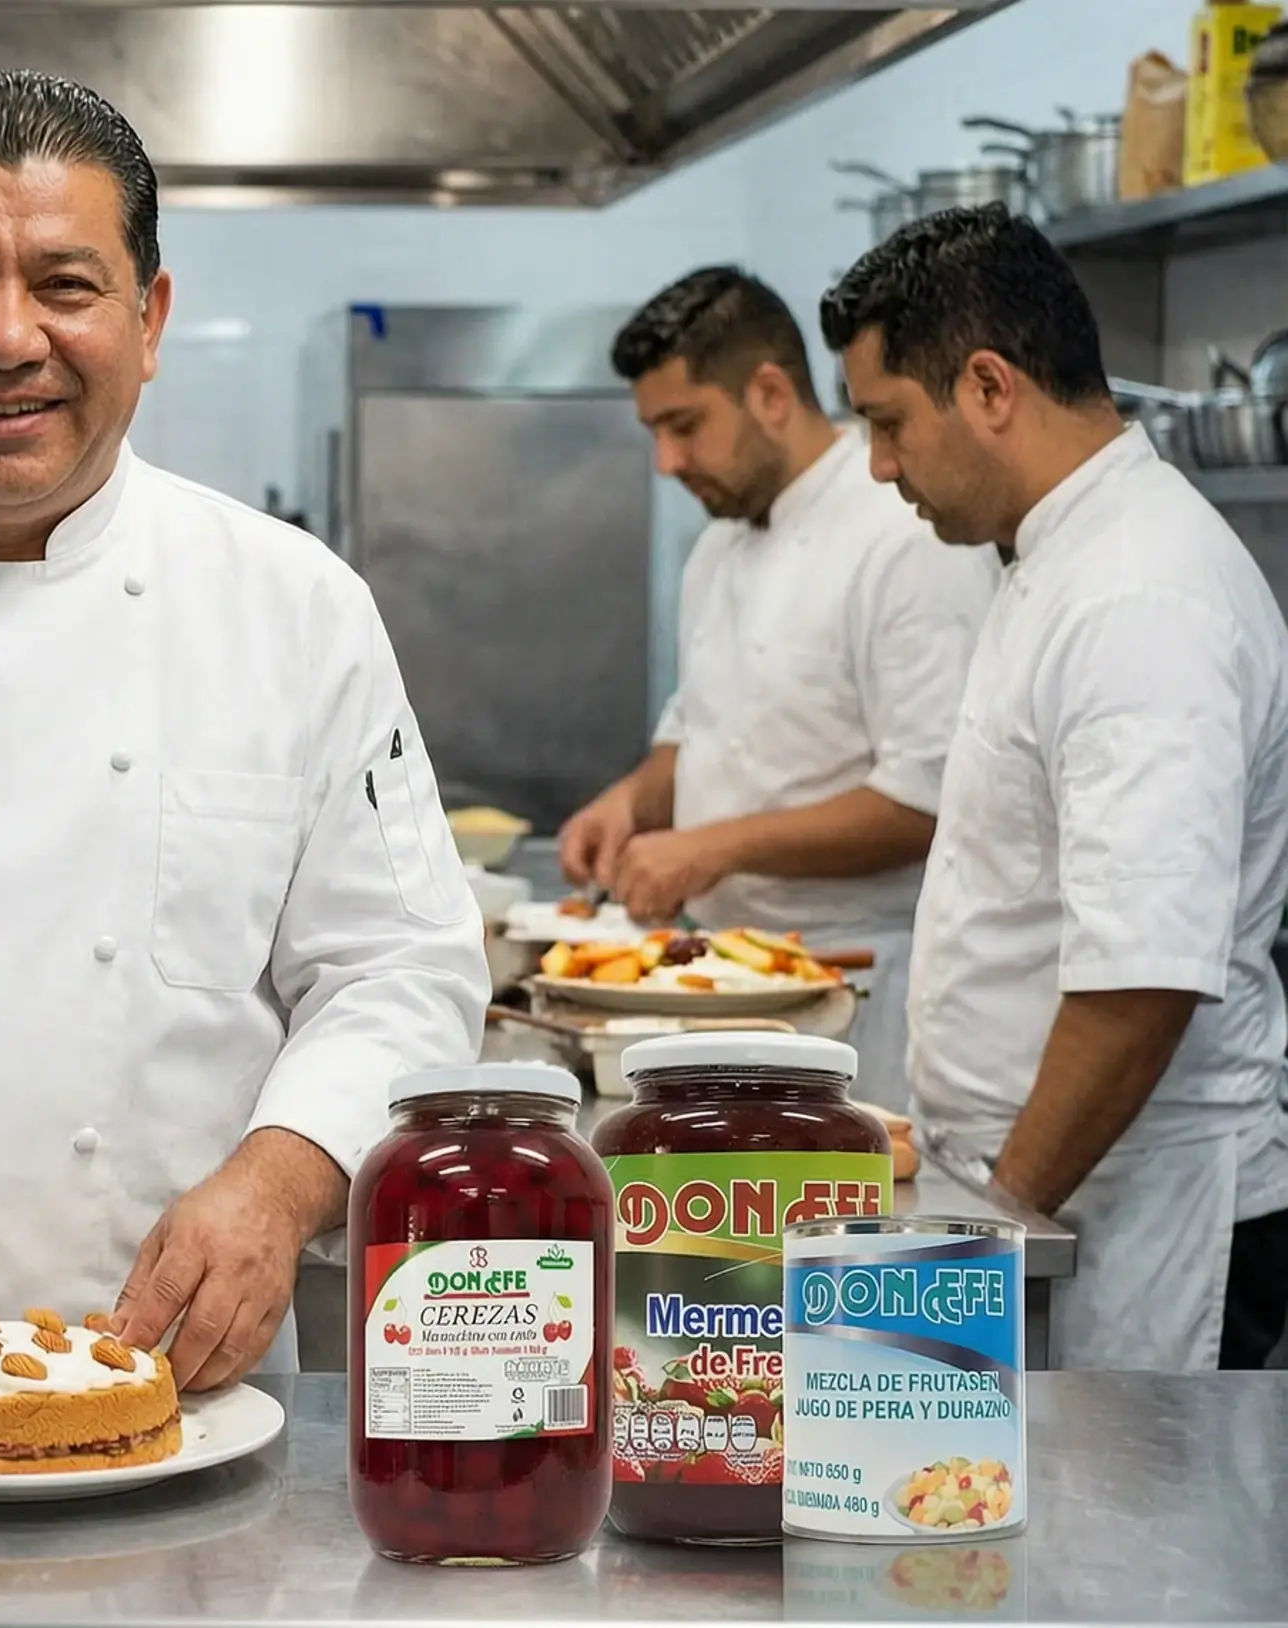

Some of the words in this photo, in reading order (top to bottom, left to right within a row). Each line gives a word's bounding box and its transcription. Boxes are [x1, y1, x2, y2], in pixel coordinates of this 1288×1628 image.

[617, 1180, 777, 1246] DON
[427, 1271, 481, 1295] DON
[484, 1270, 528, 1294] EFE
[802, 1268, 917, 1326] DON
[921, 1268, 1004, 1325] EFE
[420, 1303, 539, 1326] CEREZAS
[690, 1344, 726, 1377] de
[806, 1372, 872, 1391] MEZCLA
[877, 1373, 904, 1392] DE
[795, 1397, 831, 1418] JUGO
[835, 1400, 858, 1418] DE
[862, 1400, 915, 1419] PERA
[919, 1400, 933, 1420] Y
[937, 1399, 1011, 1420] DURAZNO
[826, 1463, 849, 1480] 650
[853, 1468, 862, 1485] g
[844, 1495, 868, 1513] 480
[871, 1501, 880, 1518] g
